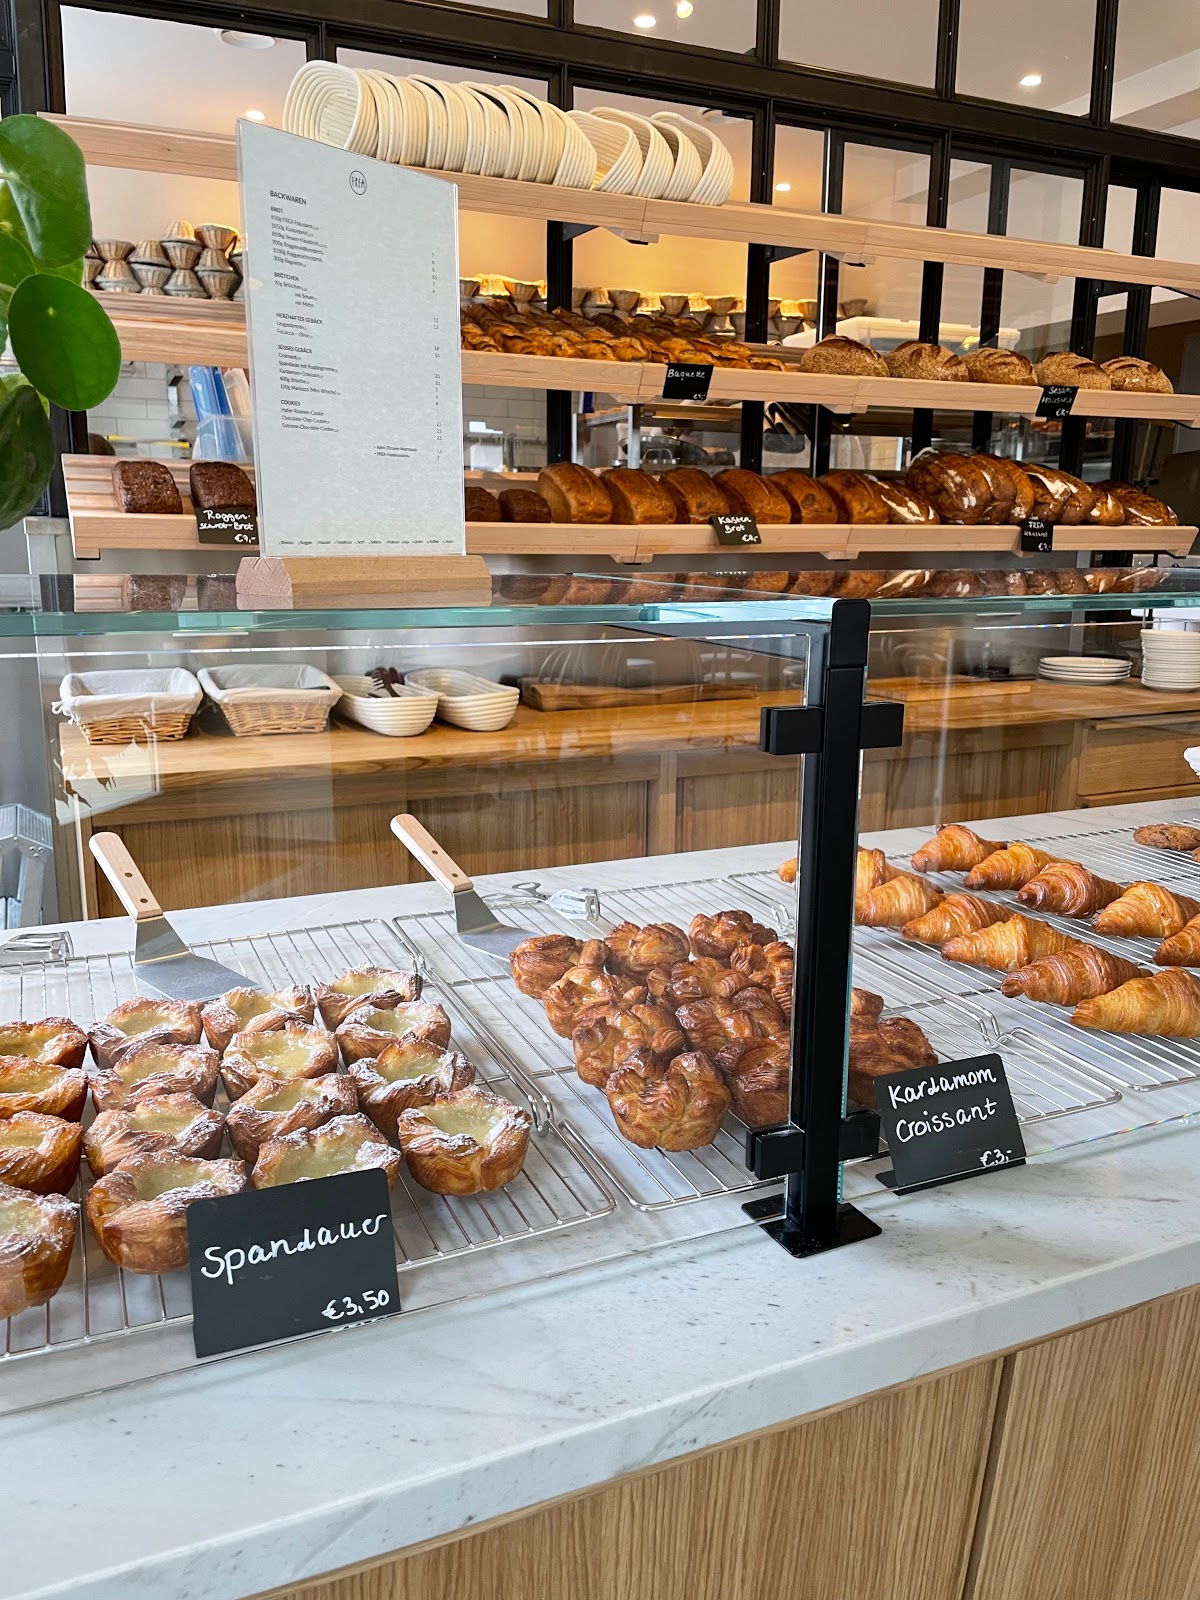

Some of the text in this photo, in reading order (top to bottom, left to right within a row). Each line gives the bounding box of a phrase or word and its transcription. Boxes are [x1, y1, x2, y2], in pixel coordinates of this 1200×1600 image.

[351, 176, 366, 189] FREA
[269, 189, 307, 206] BACKWAREN
[270, 206, 283, 214] BROT
[280, 399, 301, 407] COOKIES
[724, 524, 745, 534] Brot
[1027, 521, 1045, 529] FREA
[887, 1068, 997, 1110] Kardamom
[896, 1097, 998, 1143] Croissant
[200, 1213, 388, 1285] Spandauer
[320, 1289, 390, 1320] €3,50
